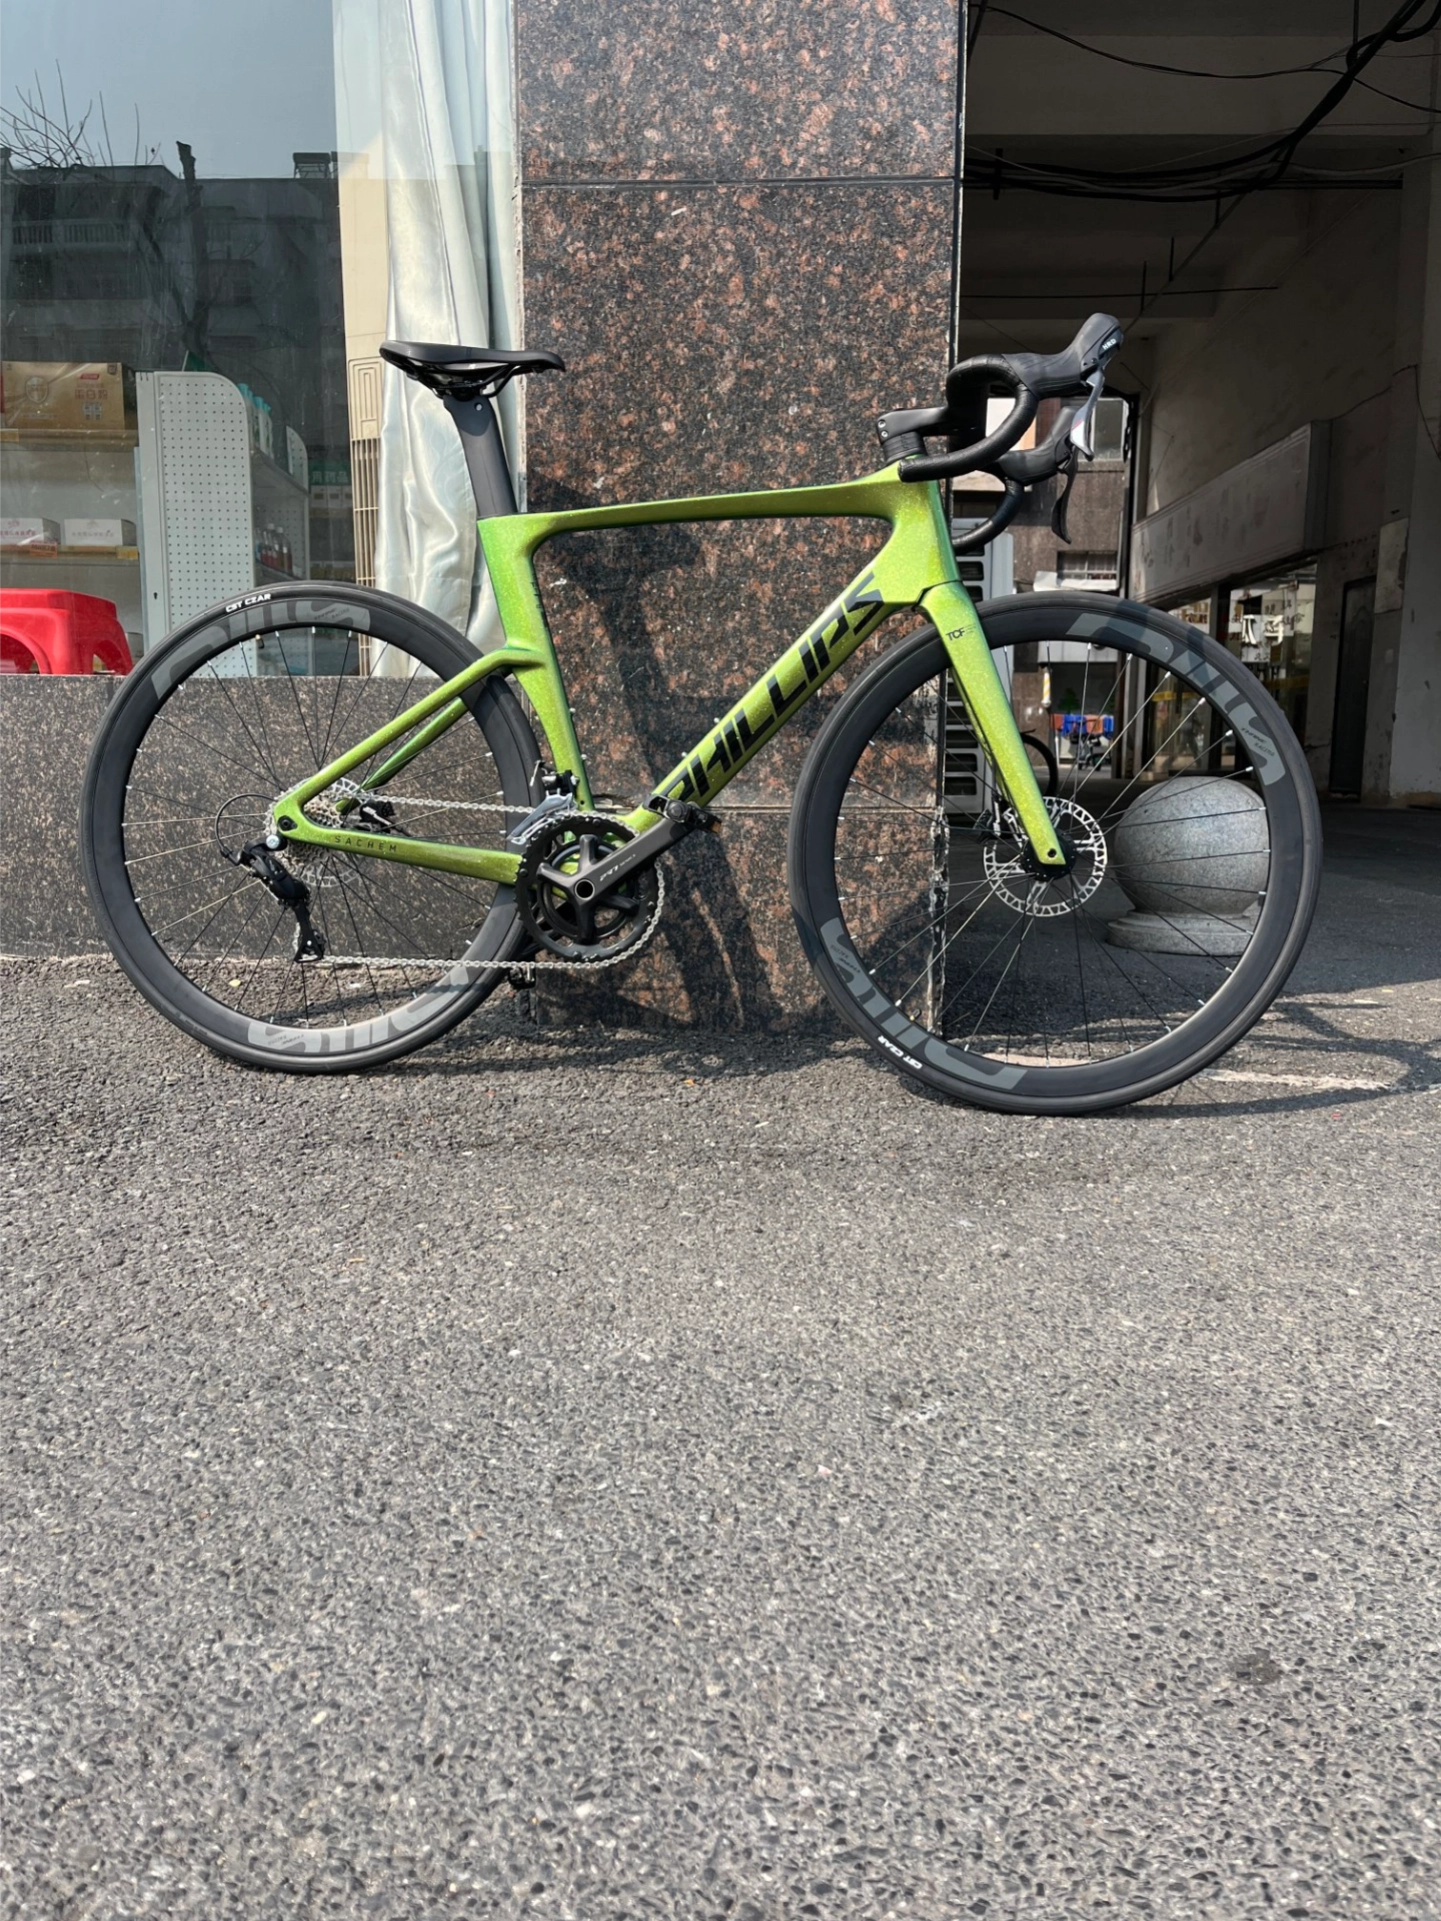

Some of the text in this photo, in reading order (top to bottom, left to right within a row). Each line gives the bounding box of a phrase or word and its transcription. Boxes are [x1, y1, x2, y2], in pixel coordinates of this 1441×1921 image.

[225, 593, 272, 613] CST CZAR
[945, 626, 965, 641] TCF
[660, 571, 884, 800] PHILLIPS
[335, 835, 397, 853] SACHEM
[877, 1035, 923, 1069] CST CZAR
